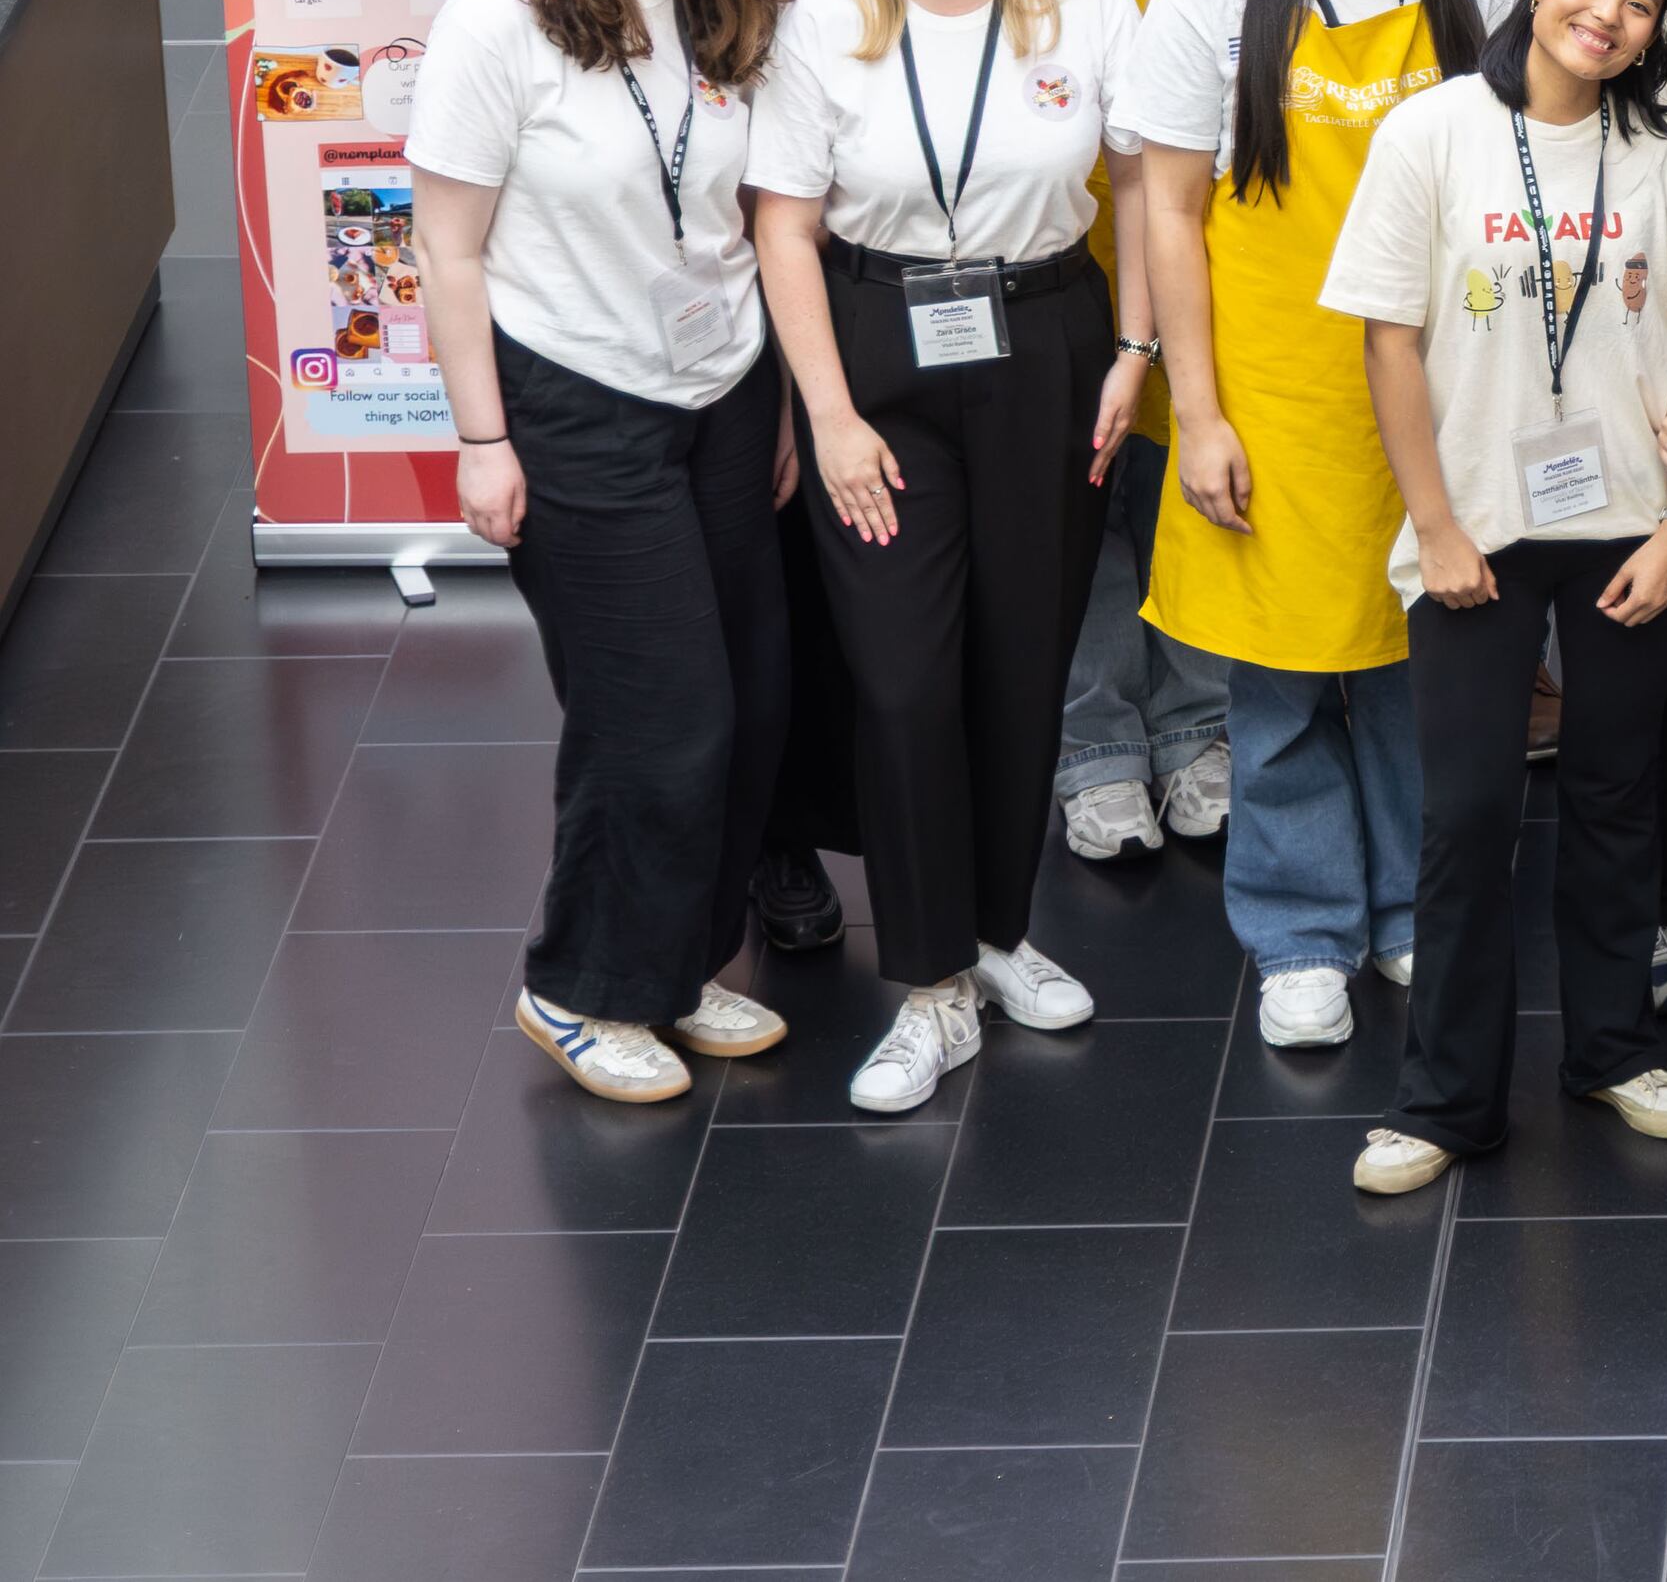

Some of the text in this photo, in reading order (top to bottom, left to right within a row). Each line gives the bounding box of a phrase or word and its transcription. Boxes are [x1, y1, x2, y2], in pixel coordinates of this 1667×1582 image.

[330, 389, 440, 402] Follow our social
